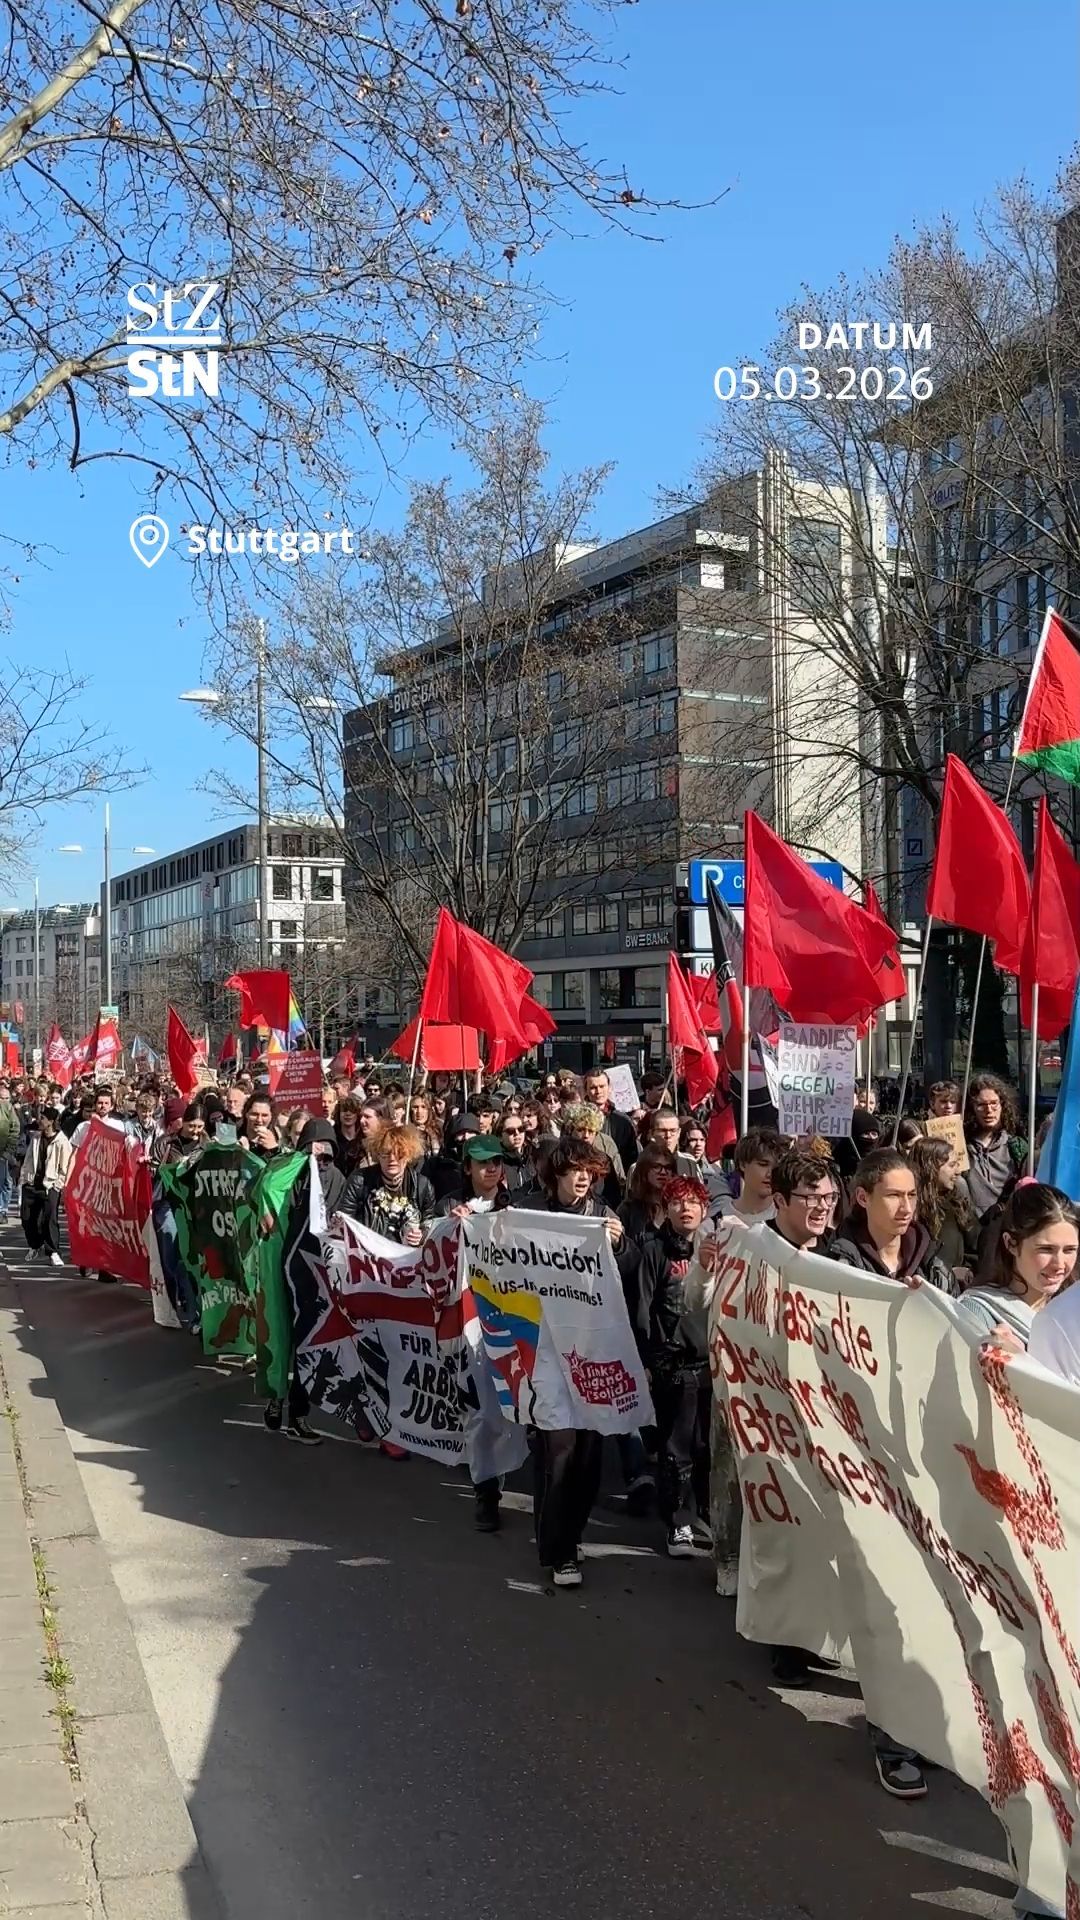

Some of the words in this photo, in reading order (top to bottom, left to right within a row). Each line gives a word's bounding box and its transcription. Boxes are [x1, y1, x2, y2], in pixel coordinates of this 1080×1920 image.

[782, 1026, 856, 1052] BADDIES
[781, 1051, 820, 1073] SIND
[780, 1074, 835, 1096] GEGEN
[781, 1094, 837, 1115] WEHR-
[783, 1114, 851, 1137] PFLICHT
[489, 1241, 603, 1277] Revolución!
[773, 1266, 829, 1355] dass
[831, 1290, 878, 1377] die
[400, 1331, 432, 1358] FÜR
[579, 1369, 624, 1393] jugend
[586, 1364, 616, 1379] links
[744, 1461, 801, 1526] rd.
